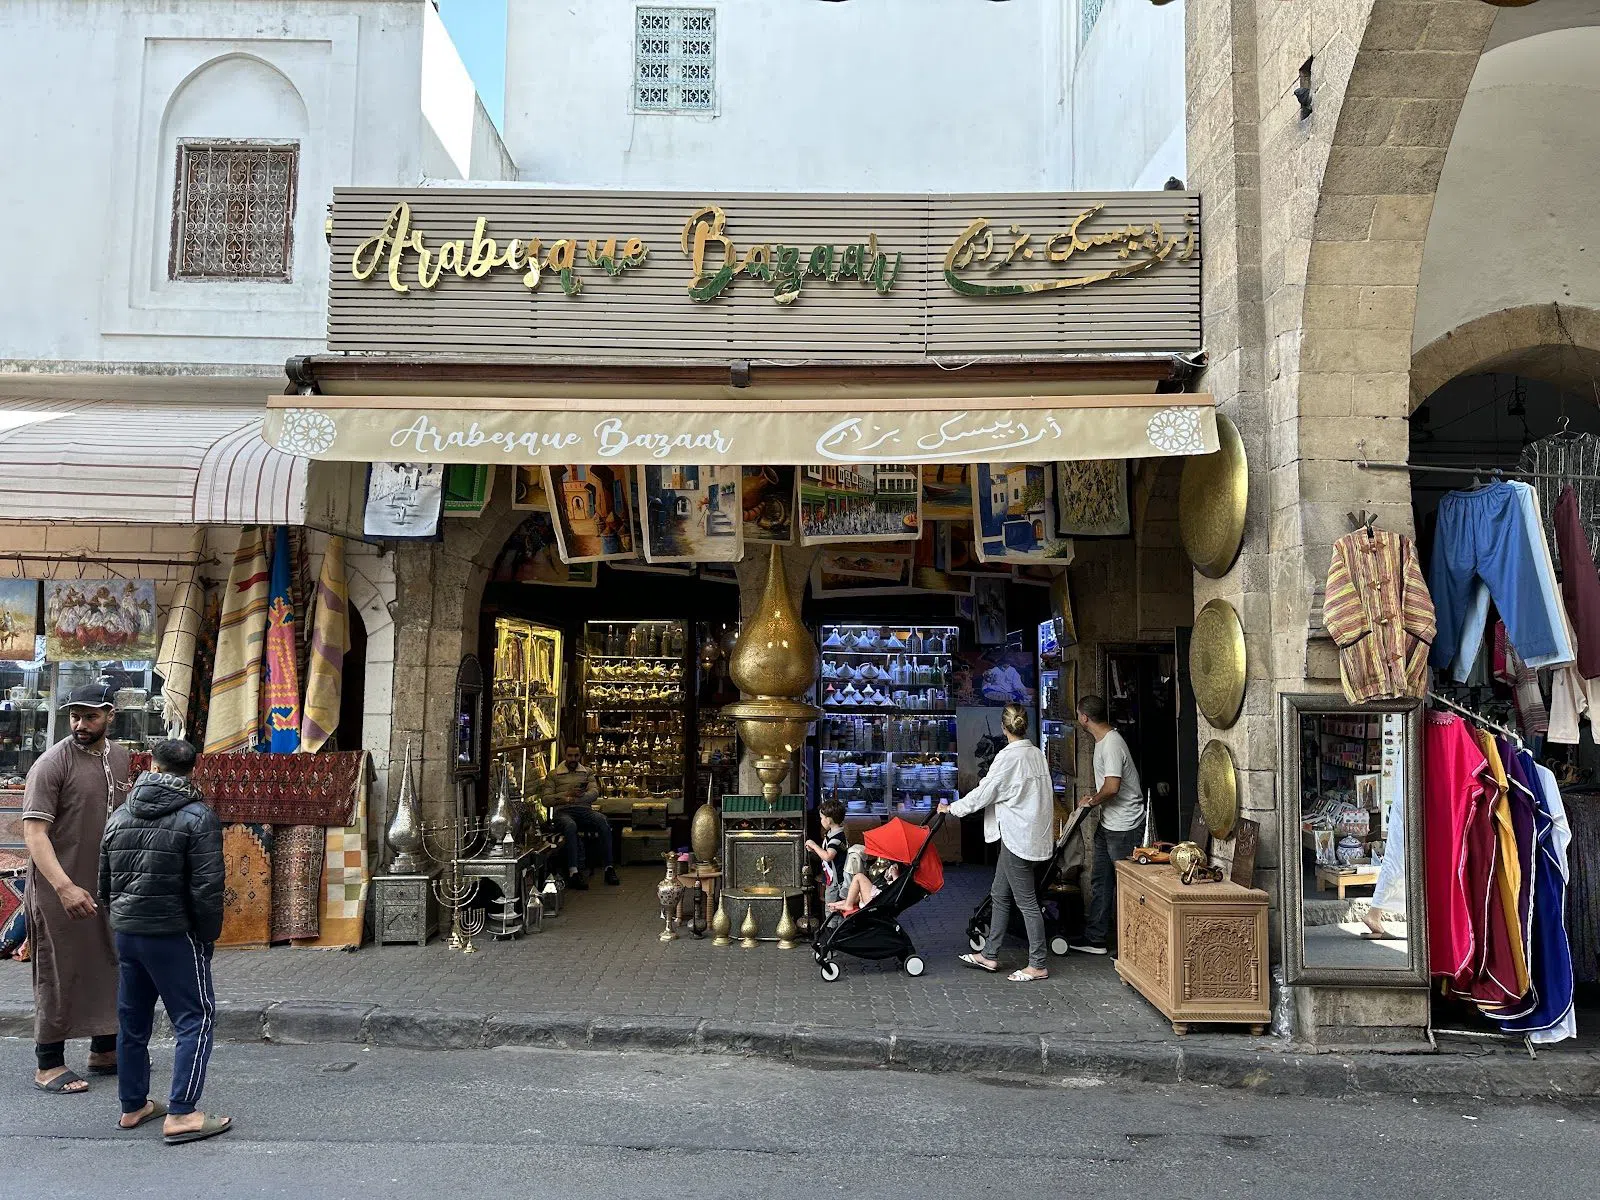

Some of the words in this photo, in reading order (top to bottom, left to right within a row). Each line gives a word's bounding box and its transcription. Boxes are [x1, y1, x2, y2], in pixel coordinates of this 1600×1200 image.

[352, 201, 650, 296] Arabesque
[681, 205, 902, 305] Bazaar
[390, 415, 582, 456] Arabesque
[594, 417, 734, 458] Bazaar
